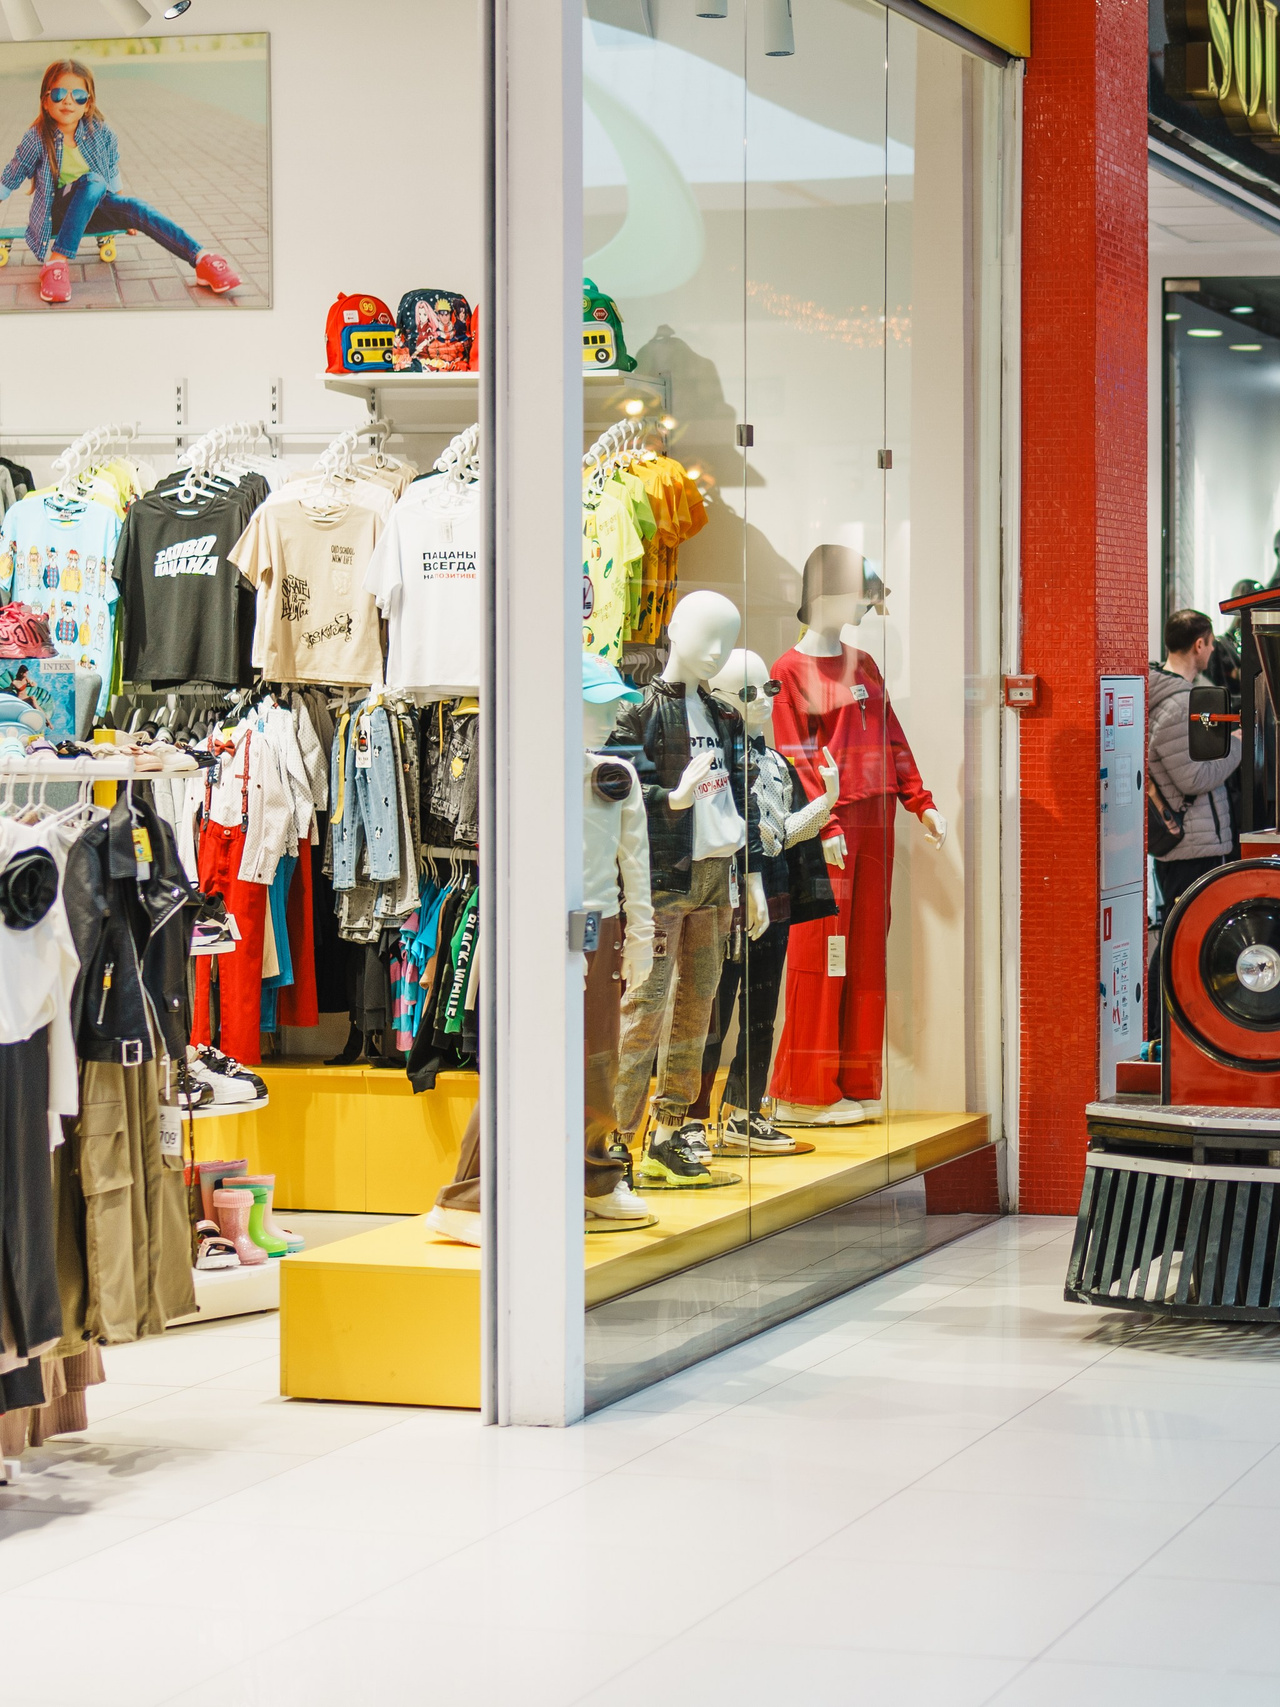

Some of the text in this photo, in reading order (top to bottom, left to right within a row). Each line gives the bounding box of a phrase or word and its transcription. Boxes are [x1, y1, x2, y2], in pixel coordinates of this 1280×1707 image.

[423, 551, 476, 560] ПАЦАНЫ
[423, 561, 476, 572] ВСЕГДА
[43, 662, 71, 671] INTEX
